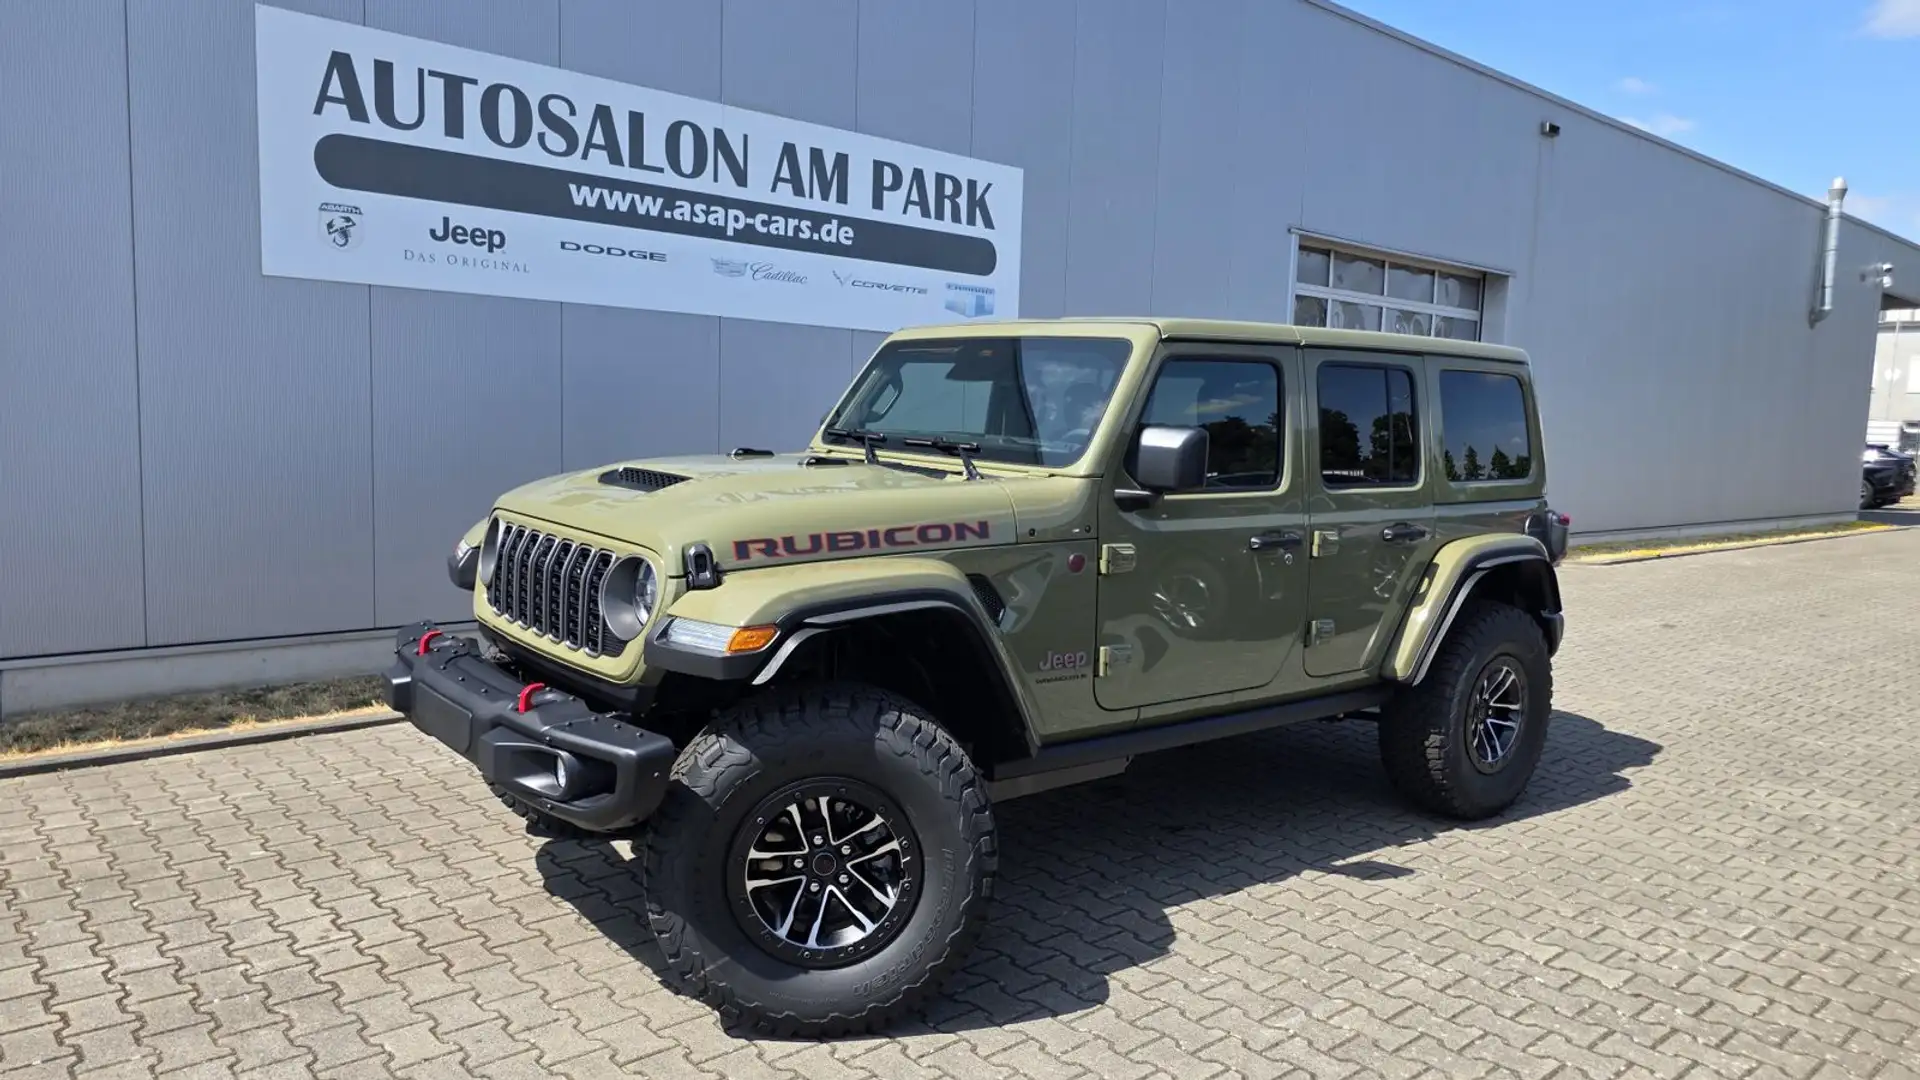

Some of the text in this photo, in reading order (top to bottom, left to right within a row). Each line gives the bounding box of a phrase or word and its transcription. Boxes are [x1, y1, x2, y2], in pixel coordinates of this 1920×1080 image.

[313, 50, 996, 230] AUTOSALON AM PARK
[568, 183, 855, 246] www.asap-cars.de
[429, 216, 507, 253] Jeep
[404, 249, 531, 274] DAS ORIGINAL
[560, 241, 667, 262] DODGE
[750, 261, 808, 285] Cadillac
[851, 279, 928, 295] CORVETTE
[732, 520, 990, 561] RUBICON
[1039, 650, 1087, 675] Jeep
